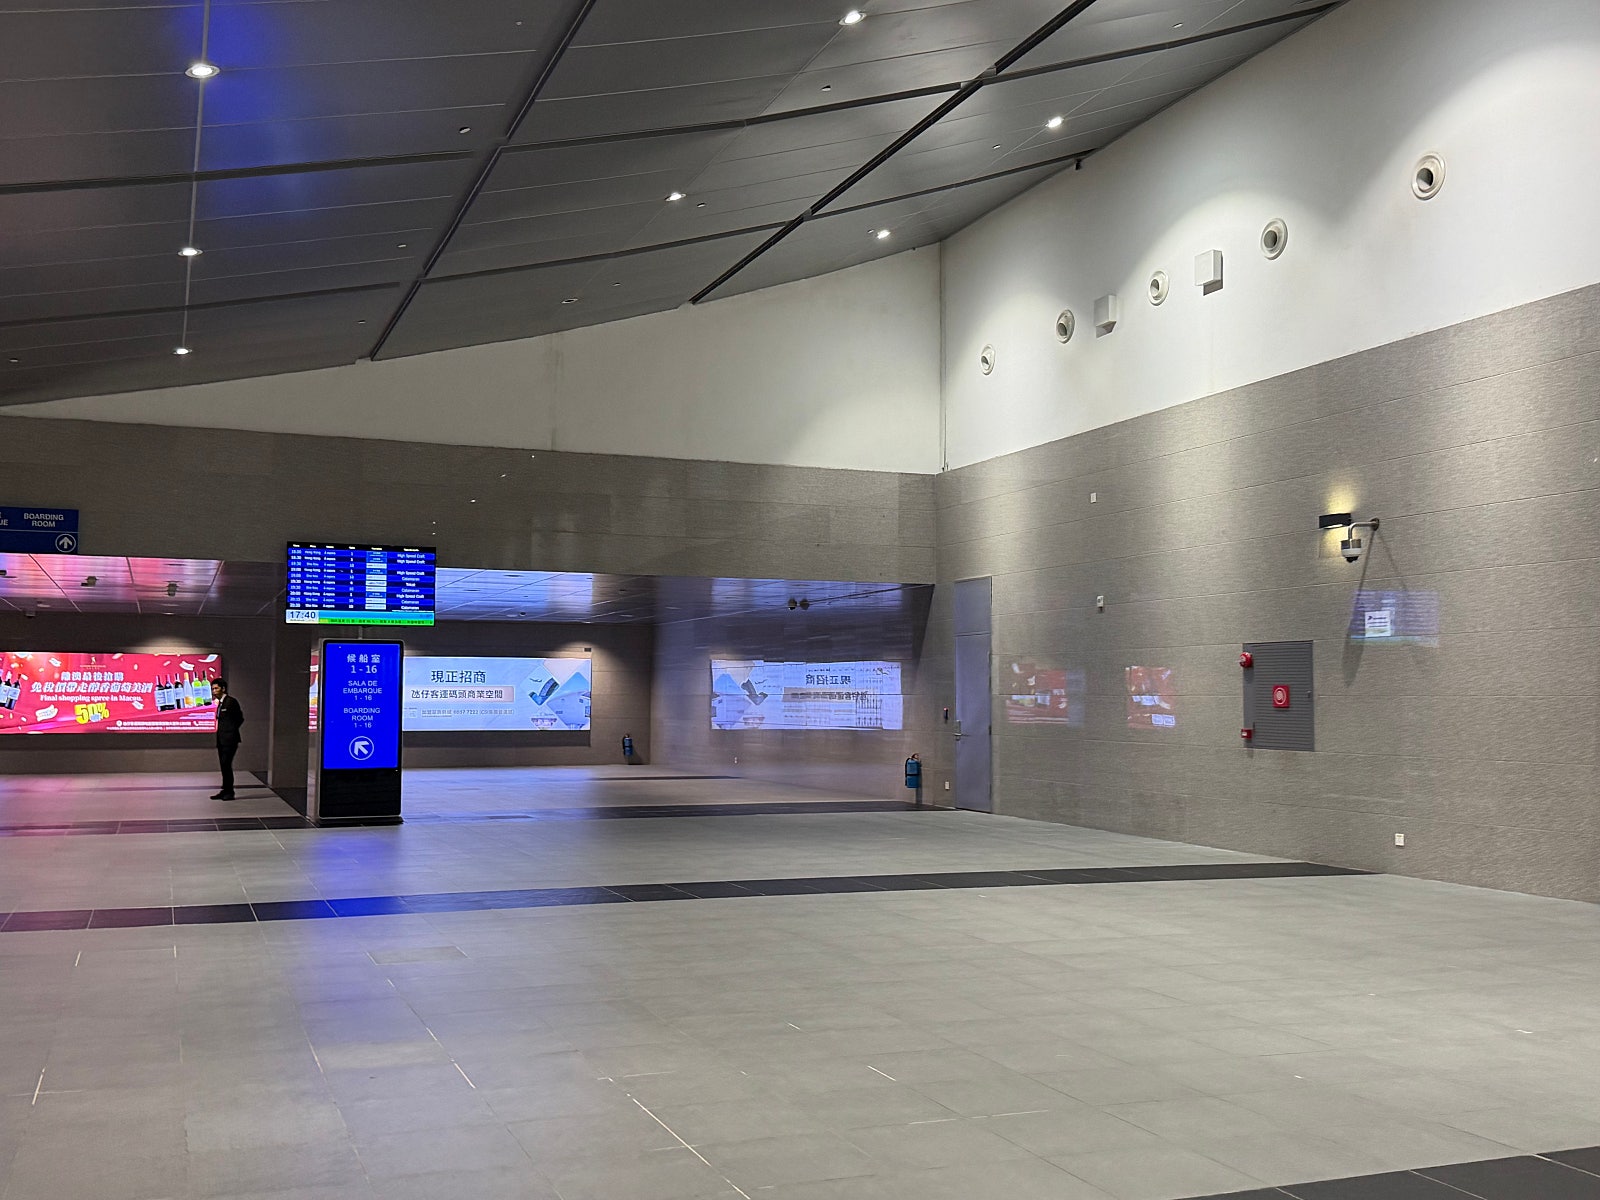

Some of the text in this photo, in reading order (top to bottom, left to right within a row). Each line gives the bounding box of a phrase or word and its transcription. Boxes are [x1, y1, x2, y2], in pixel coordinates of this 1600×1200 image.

[347, 654, 380, 663] 候船室
[351, 665, 356, 673] 1
[366, 665, 377, 673] 16
[431, 671, 486, 683] 現正招商
[75, 702, 110, 724] 50%
